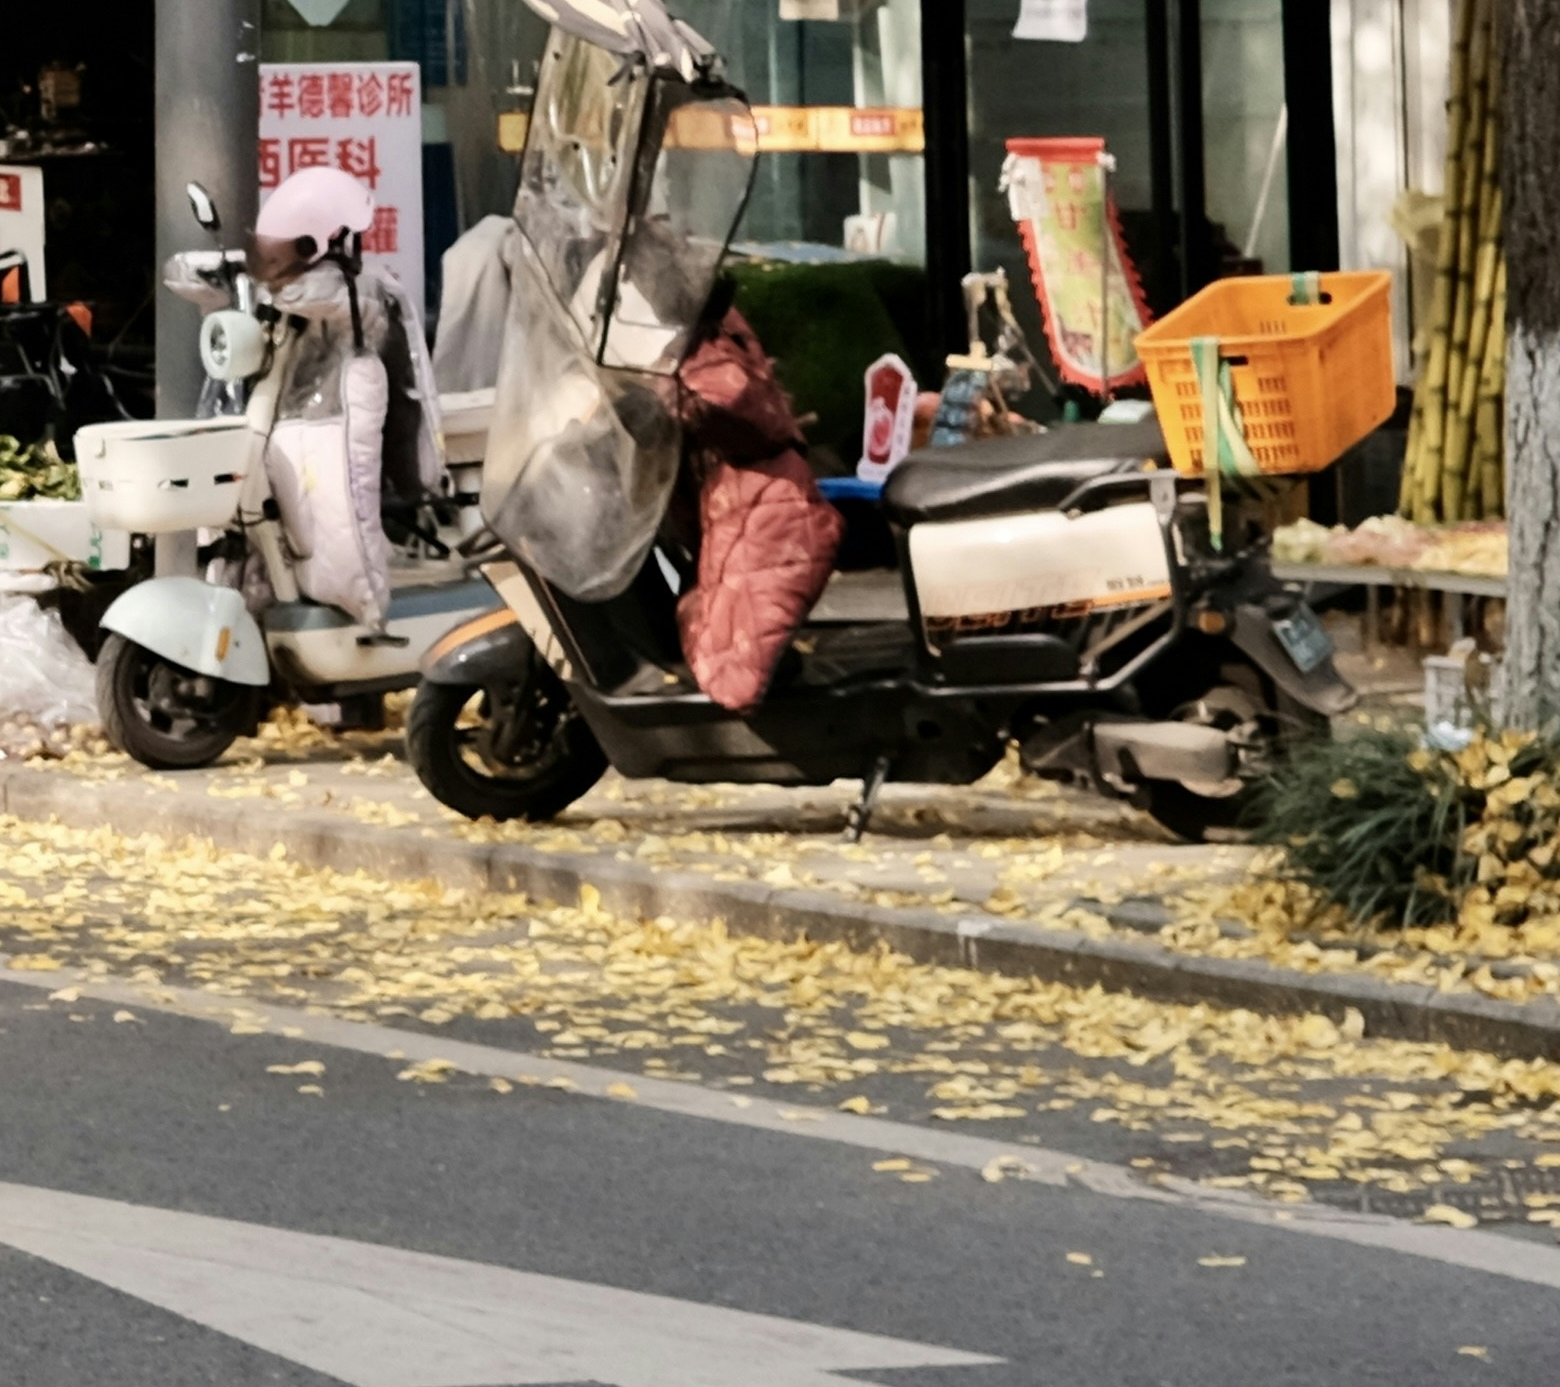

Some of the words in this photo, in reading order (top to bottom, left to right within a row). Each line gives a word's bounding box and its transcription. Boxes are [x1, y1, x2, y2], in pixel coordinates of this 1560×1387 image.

[258, 73, 414, 120] 羊德馨诊所
